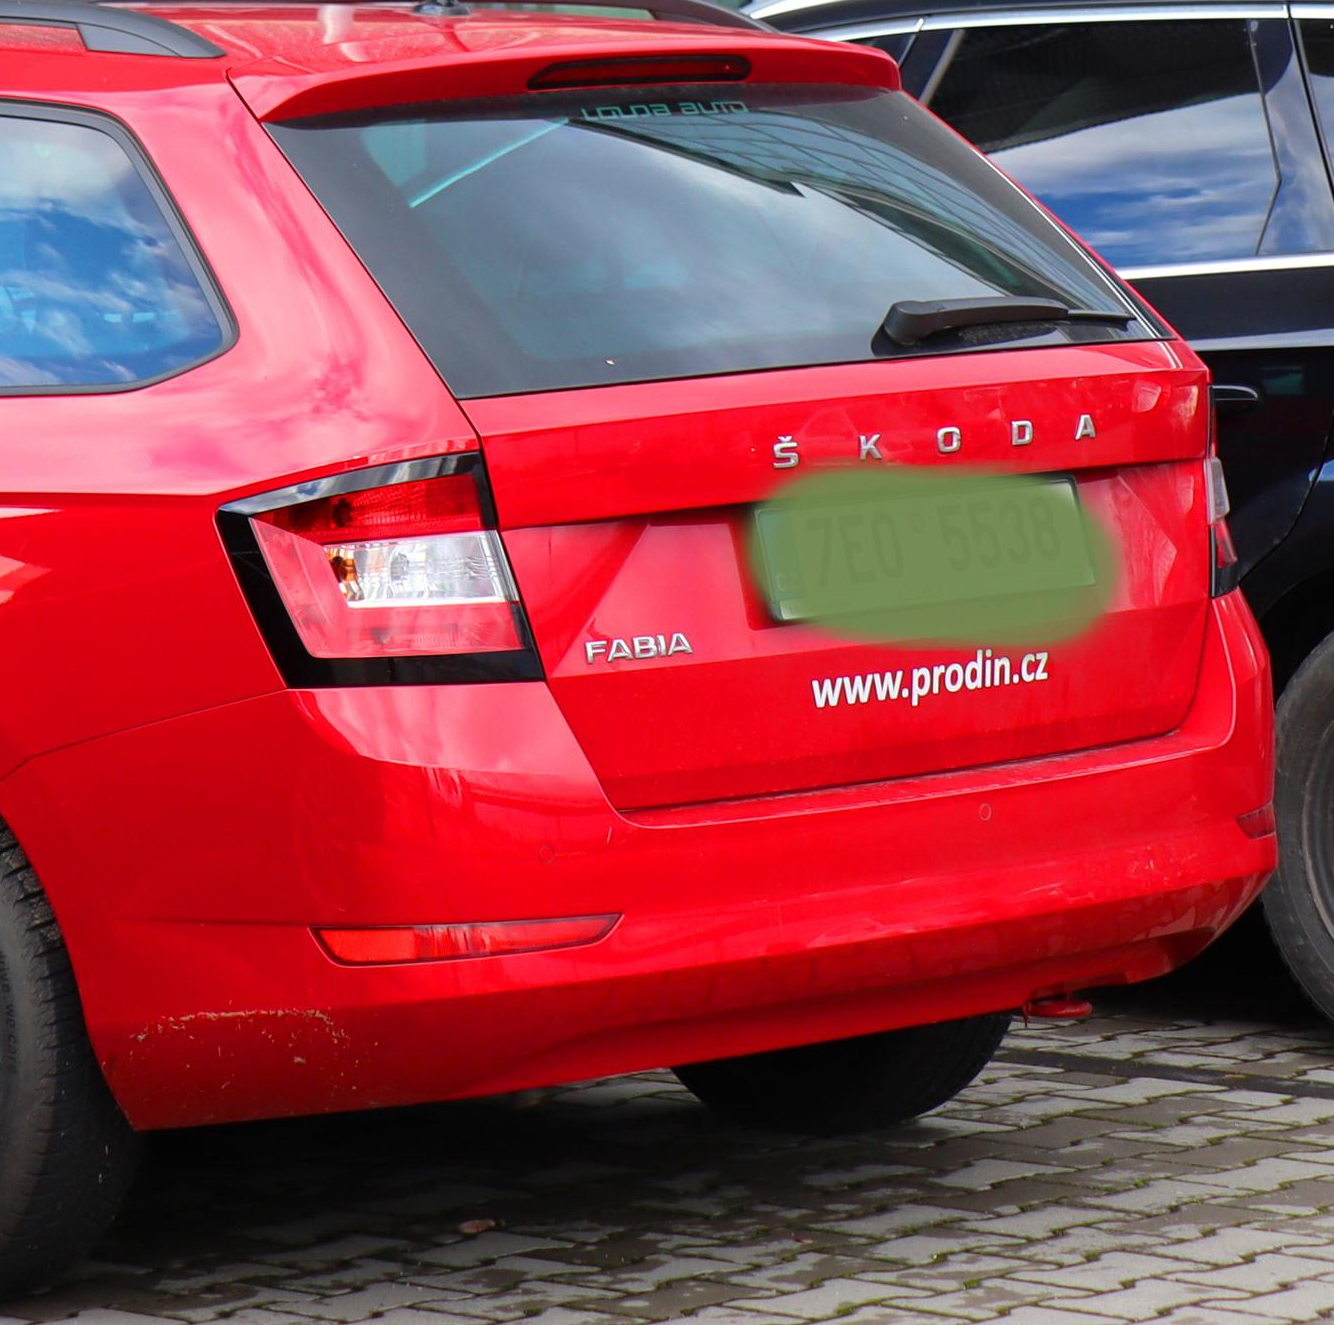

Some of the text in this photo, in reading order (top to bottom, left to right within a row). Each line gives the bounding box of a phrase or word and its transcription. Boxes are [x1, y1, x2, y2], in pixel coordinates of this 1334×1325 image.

[772, 413, 1097, 469] ŠKODA
[585, 632, 694, 665] FABIA
[811, 648, 1050, 709] www.prodin.cz
